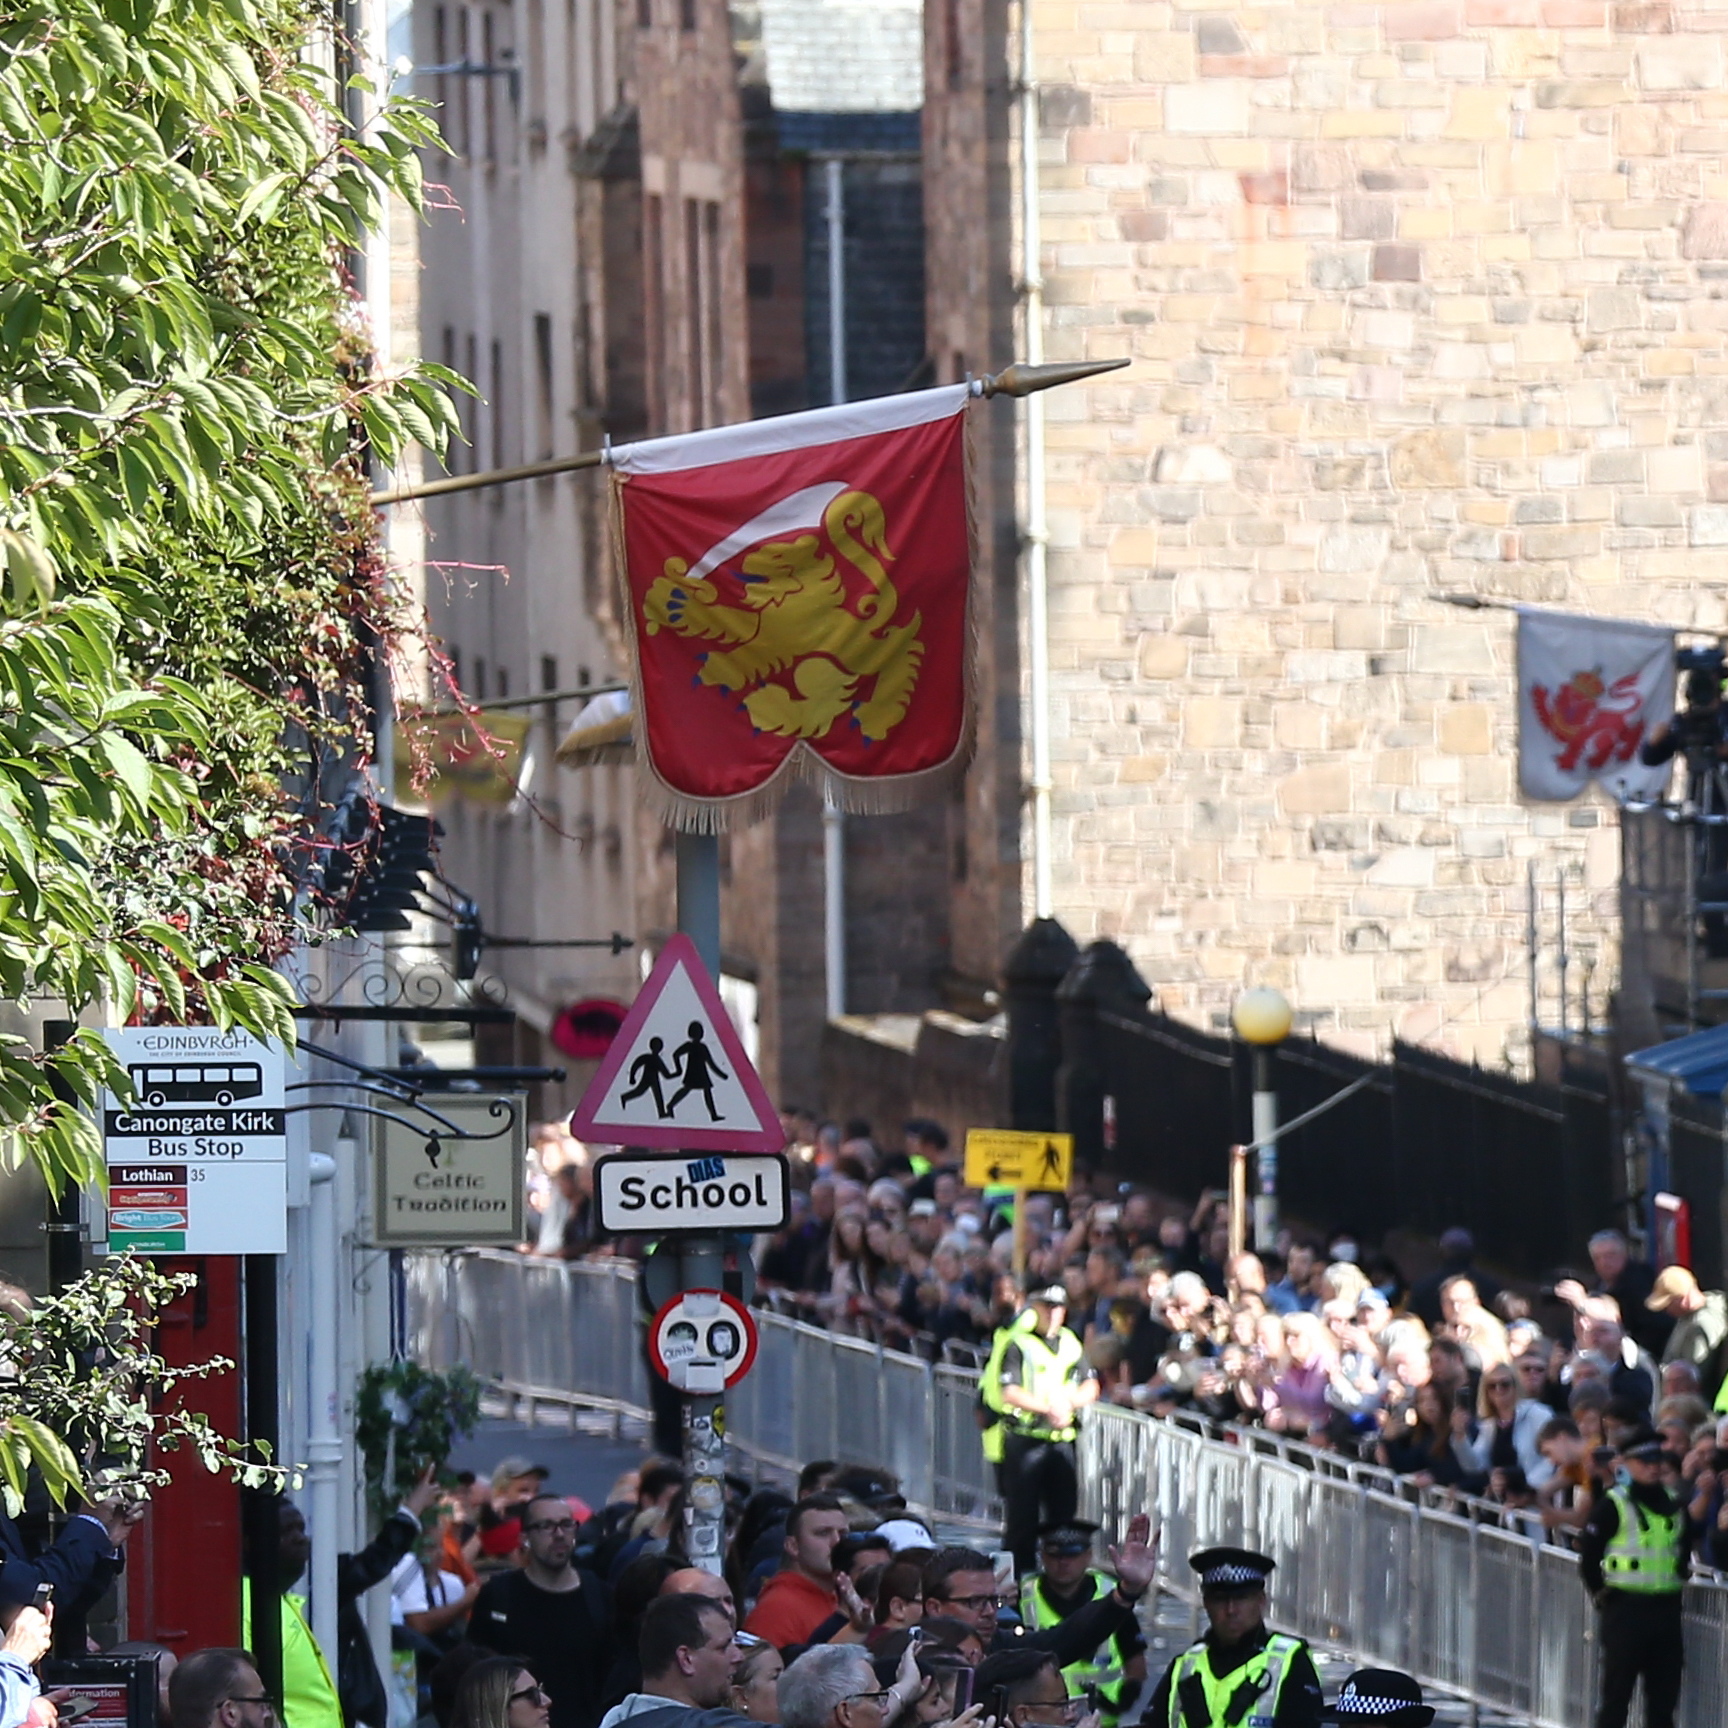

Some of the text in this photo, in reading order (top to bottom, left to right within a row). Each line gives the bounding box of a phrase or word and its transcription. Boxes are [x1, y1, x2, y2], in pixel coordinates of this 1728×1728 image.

[115, 1112, 275, 1135] Canongate Kirk
[148, 1138, 244, 1159] Bus Stop
[122, 1169, 205, 1182] Lothian 35
[413, 1171, 486, 1190] Celtic
[619, 1174, 768, 1211] School
[393, 1194, 507, 1212] Tradition
